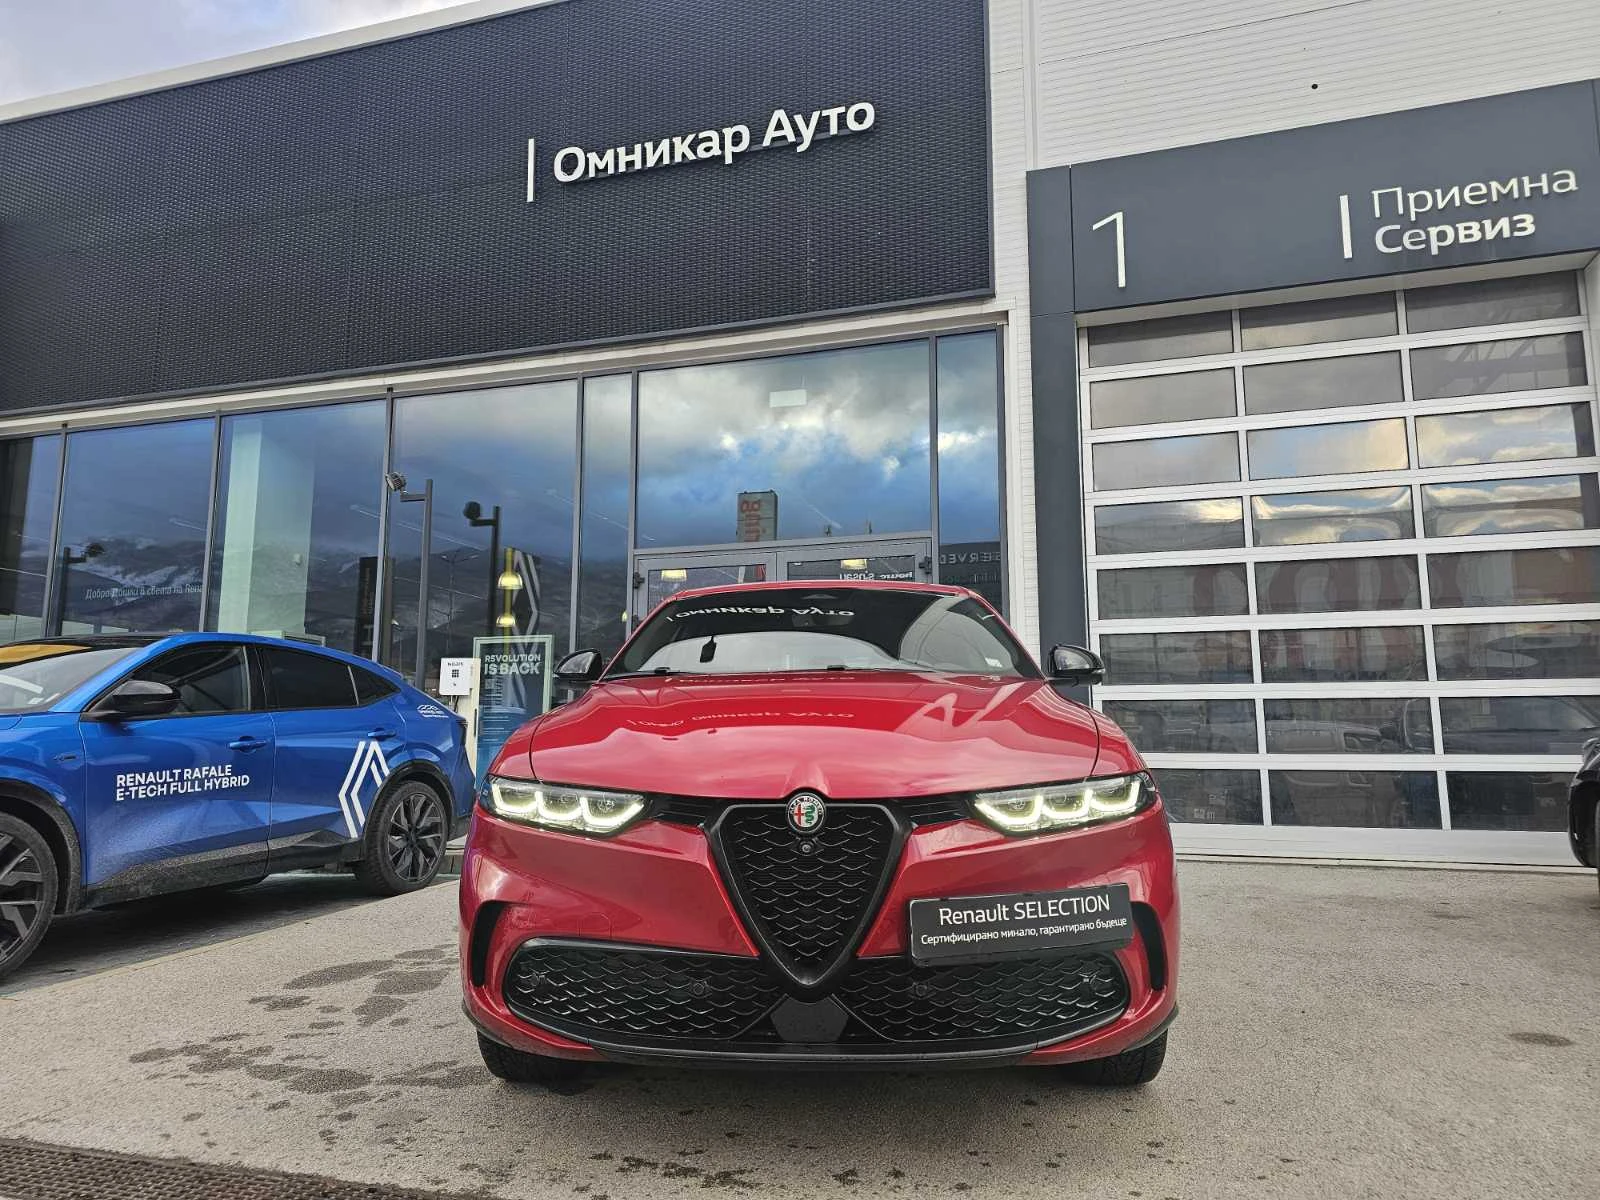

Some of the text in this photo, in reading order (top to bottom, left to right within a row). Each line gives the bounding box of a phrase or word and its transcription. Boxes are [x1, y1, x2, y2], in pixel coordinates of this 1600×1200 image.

[553, 102, 875, 183] Омникар Ауто
[1371, 170, 1579, 221] Приемна
[1092, 211, 1126, 288] 1
[1374, 213, 1536, 255] Сервиз
[484, 662, 542, 675] IS BACK
[116, 764, 233, 787] RENAULT RAFALE
[116, 774, 251, 801] E-TECH FULL HYBRID
[938, 893, 1111, 926] Renault SELECTION
[920, 917, 1128, 946] Сертифицирано минало, гарантирано бъдеще
